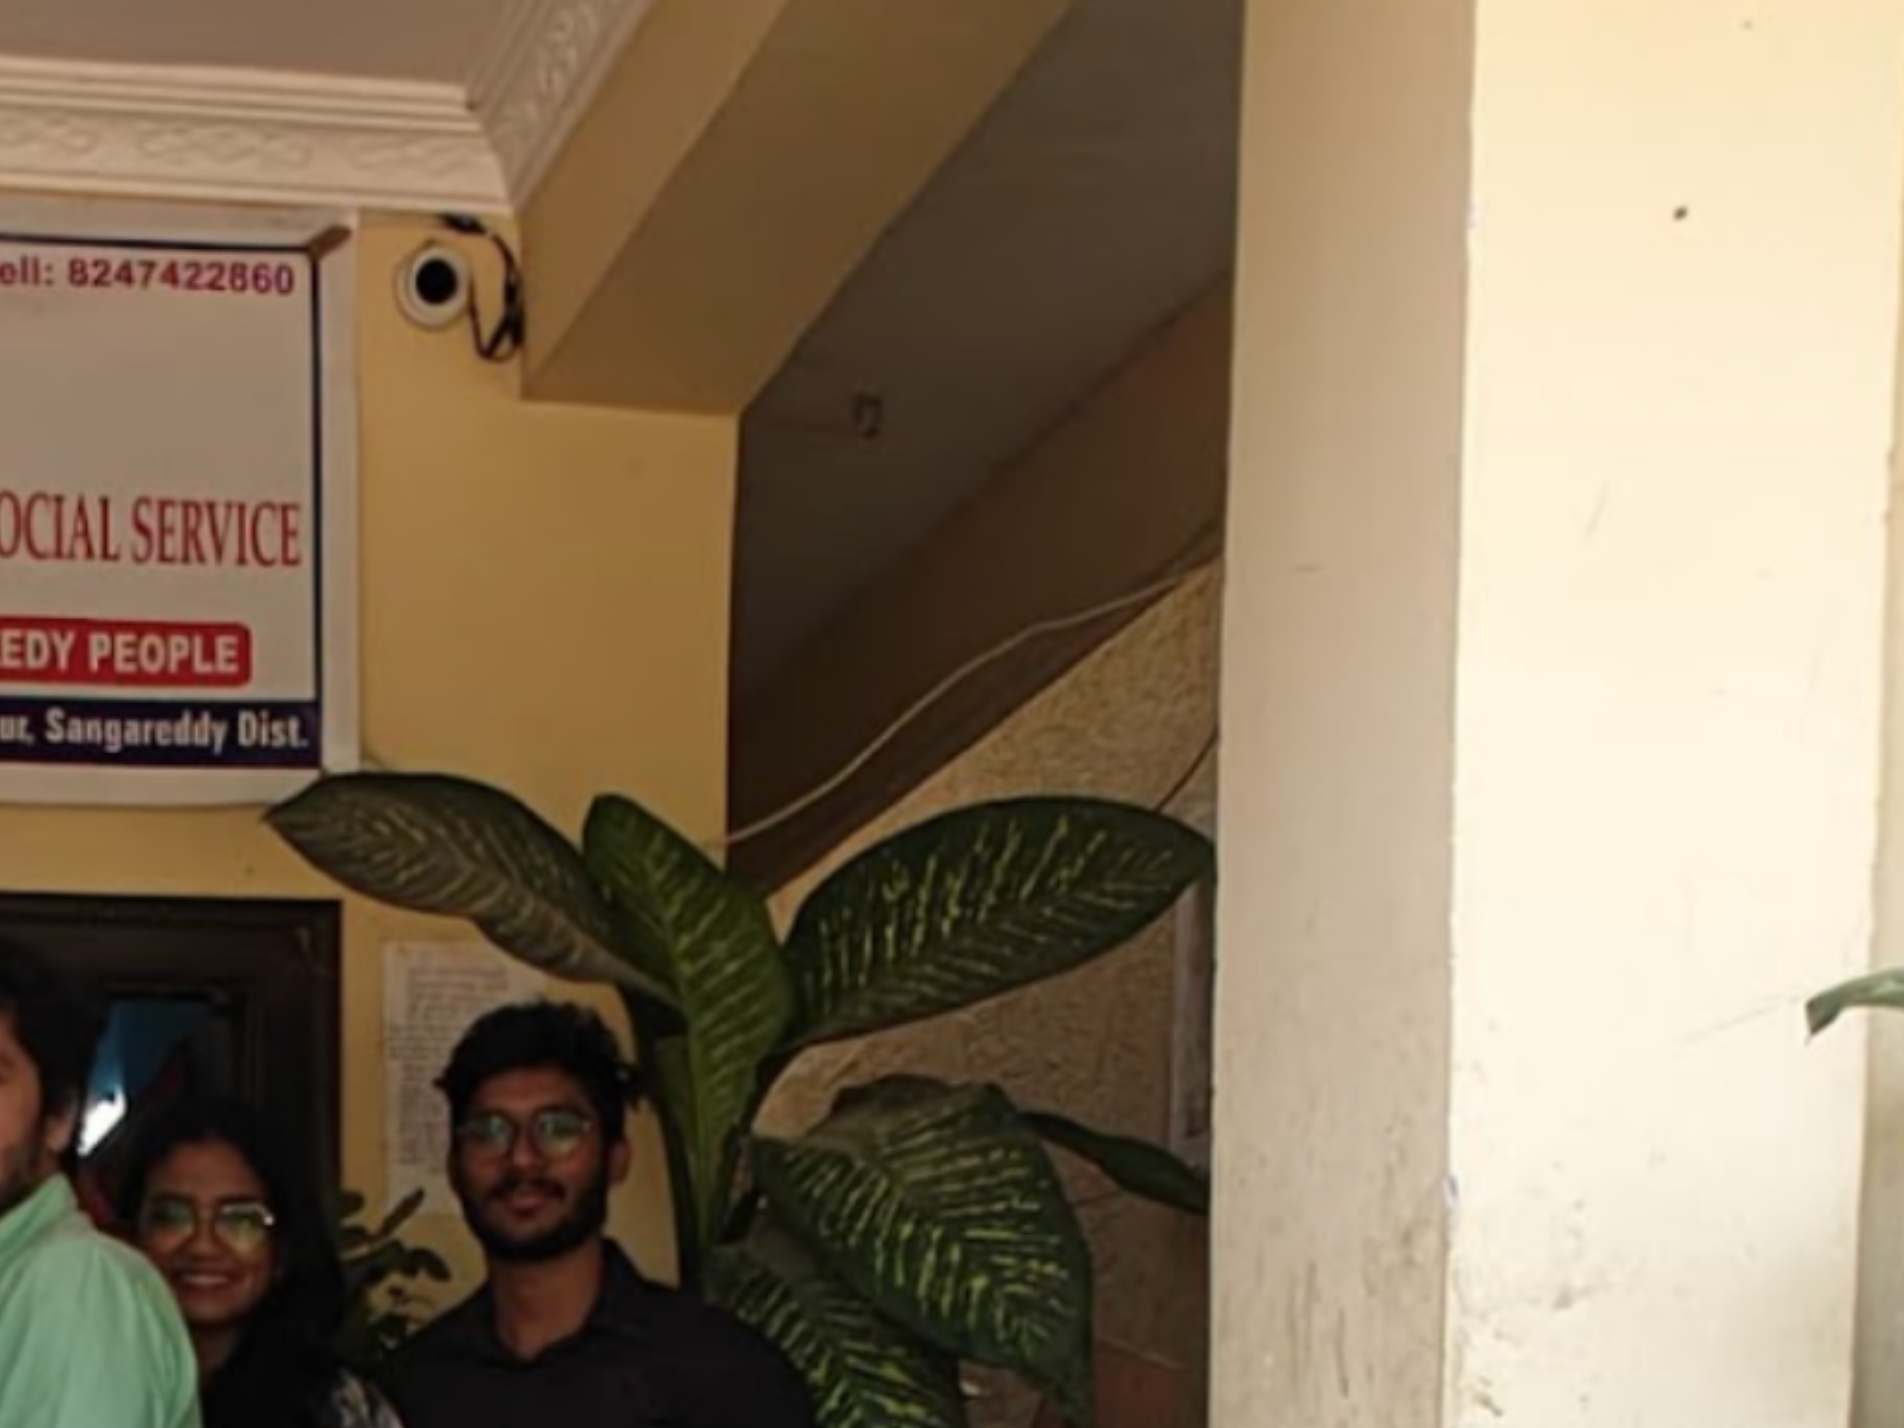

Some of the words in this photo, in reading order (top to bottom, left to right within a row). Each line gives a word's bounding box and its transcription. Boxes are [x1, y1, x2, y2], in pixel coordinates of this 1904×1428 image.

[131, 497, 301, 567] SERVICE
[89, 631, 239, 674] PEOPLE
[45, 707, 227, 754] Sangareddy
[237, 711, 308, 748] Dist.
